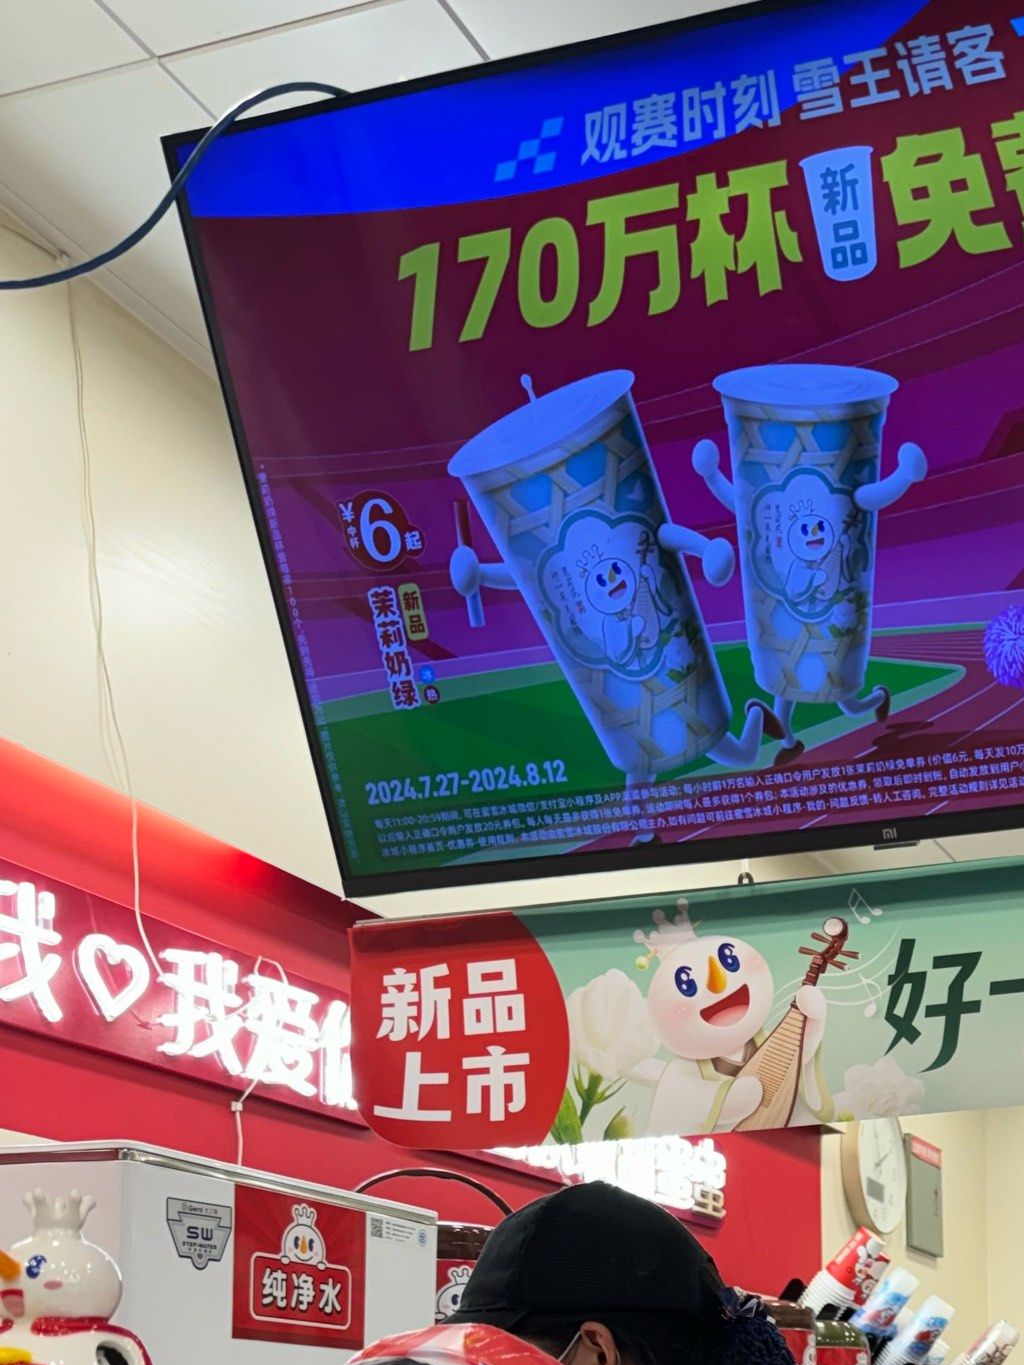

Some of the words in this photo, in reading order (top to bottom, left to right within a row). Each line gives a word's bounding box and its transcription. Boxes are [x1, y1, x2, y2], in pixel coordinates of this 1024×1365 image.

[582, 72, 782, 167] 观赛时刻
[793, 26, 1006, 121] 雪王请客
[397, 160, 803, 353] 170万杯
[820, 165, 868, 271] 新品
[360, 499, 401, 563] 6
[404, 530, 423, 551] 起
[370, 588, 419, 708] 茉莉奶绿
[402, 591, 425, 635] 新品
[365, 759, 568, 806] 2024.7.27-2024.8.12
[376, 958, 528, 1043] 新品
[373, 1044, 531, 1124] 上市
[186, 1225, 214, 1242] SW
[261, 1266, 344, 1316] 纯净水
